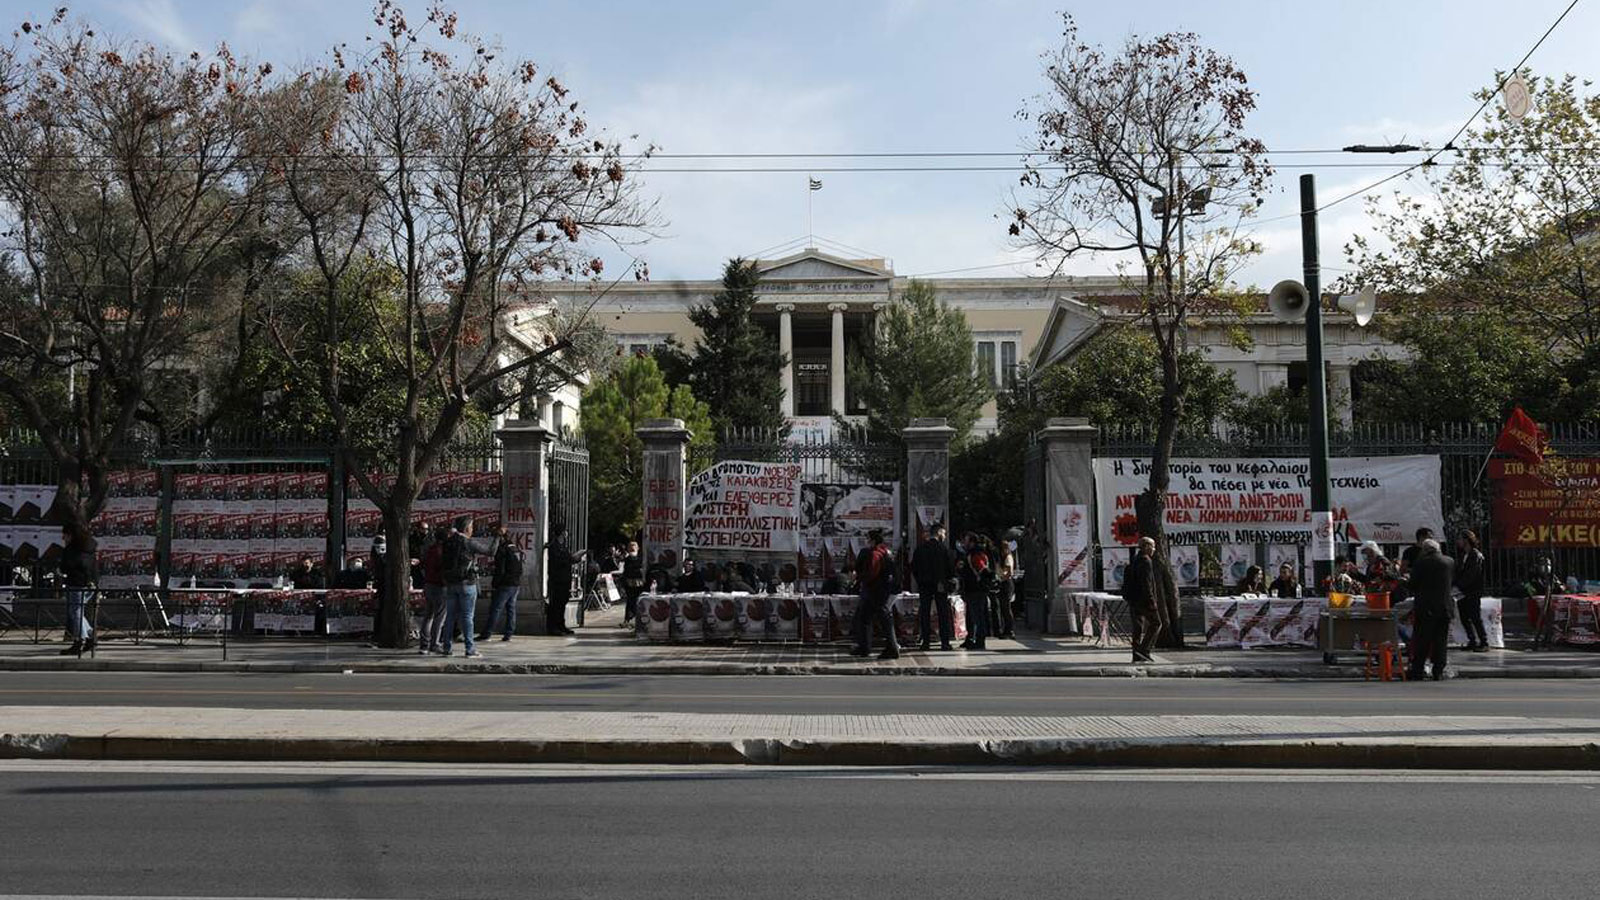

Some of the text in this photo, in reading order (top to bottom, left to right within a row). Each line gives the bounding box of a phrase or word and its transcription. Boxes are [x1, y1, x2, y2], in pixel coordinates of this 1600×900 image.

[745, 464, 761, 475] ΤΟΥ
[1114, 459, 1308, 479] Η δικτορία του κεφαλαίου
[1504, 462, 1524, 475] ΣΤΟ
[1189, 475, 1207, 490] θα
[1252, 480, 1266, 492] με
[1269, 478, 1290, 490] νέα
[1297, 473, 1381, 489] Ποτεχνεία
[1239, 492, 1305, 509] ΑΝΑΤΡΟΠΗ
[508, 507, 536, 521] ΗΠΑ
[1166, 509, 1192, 523] ΝΕΑ
[685, 530, 771, 548] ΣΥΣΠΕΙΡΩΣΗ
